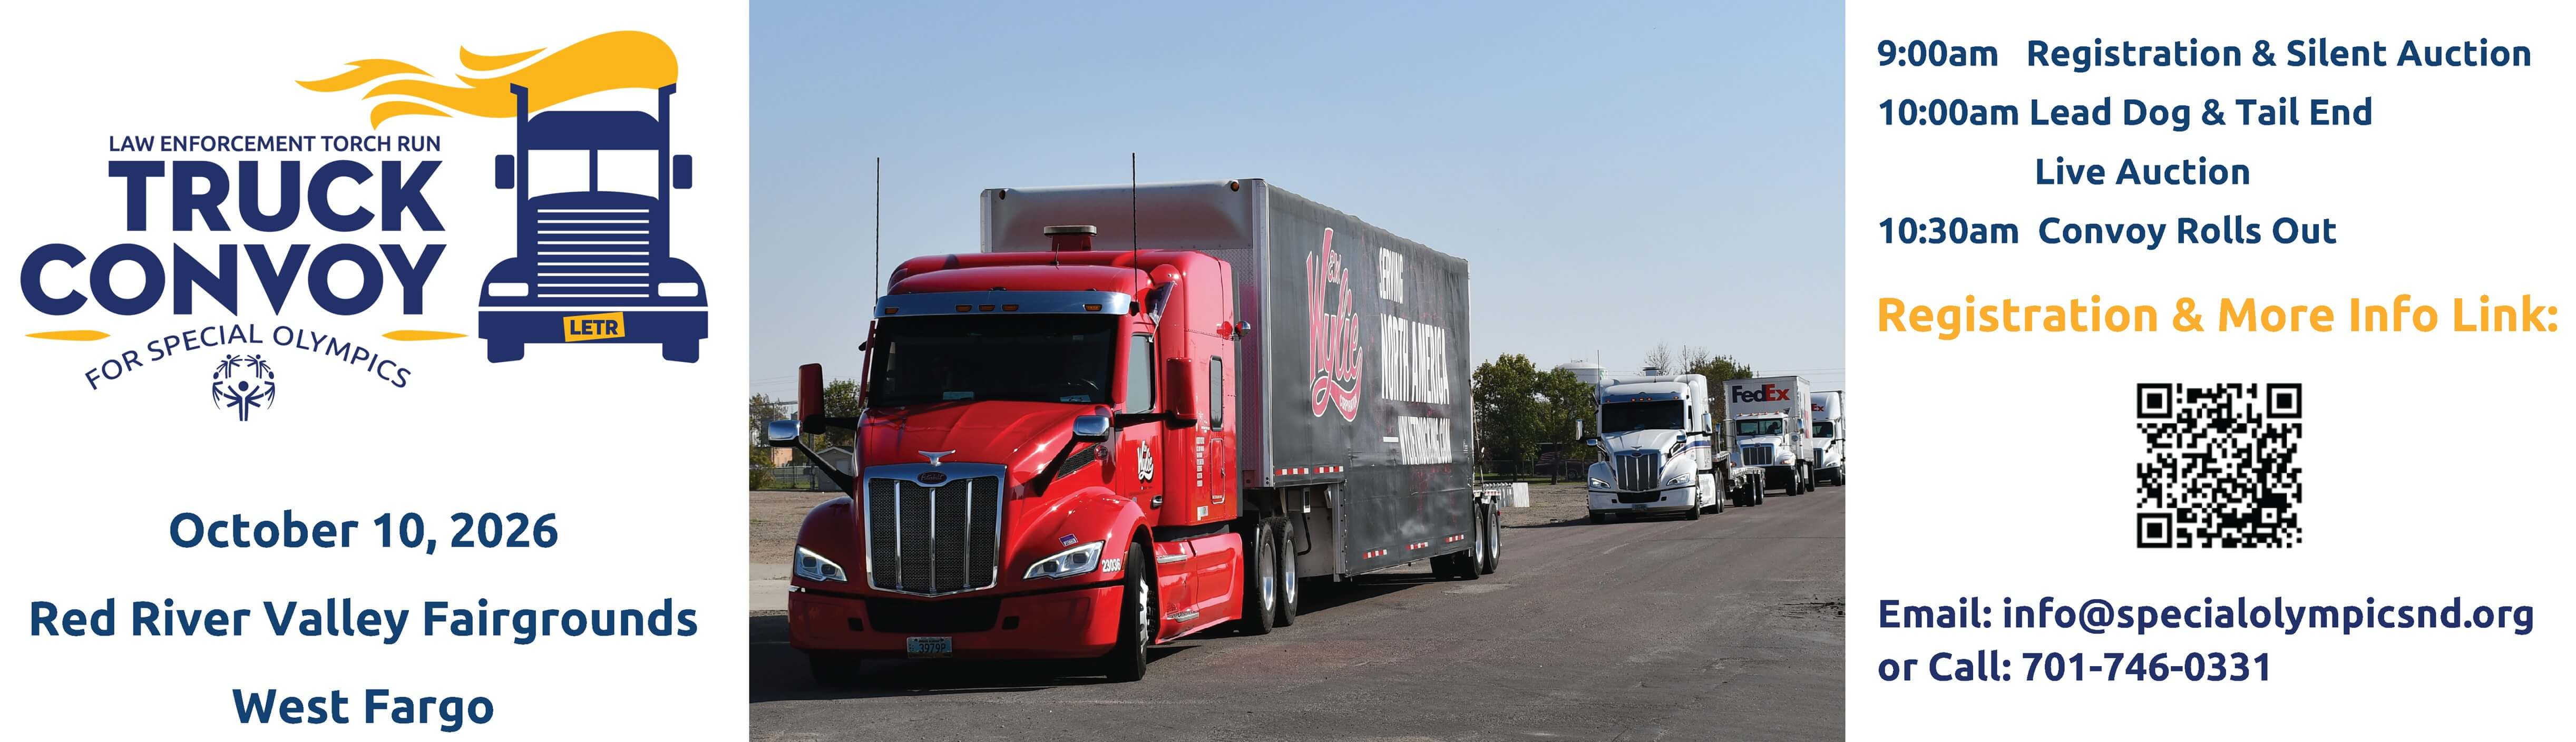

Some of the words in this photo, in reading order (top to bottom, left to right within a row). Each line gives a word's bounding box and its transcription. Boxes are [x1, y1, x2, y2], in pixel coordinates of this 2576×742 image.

[1379, 247, 1403, 304] SERVING
[1306, 228, 1363, 422] Wylie
[1381, 313, 1409, 402] NORTH
[1412, 321, 1450, 405] AMERICA
[1732, 384, 1790, 403] FedEx
[1102, 559, 1121, 572] 23036
